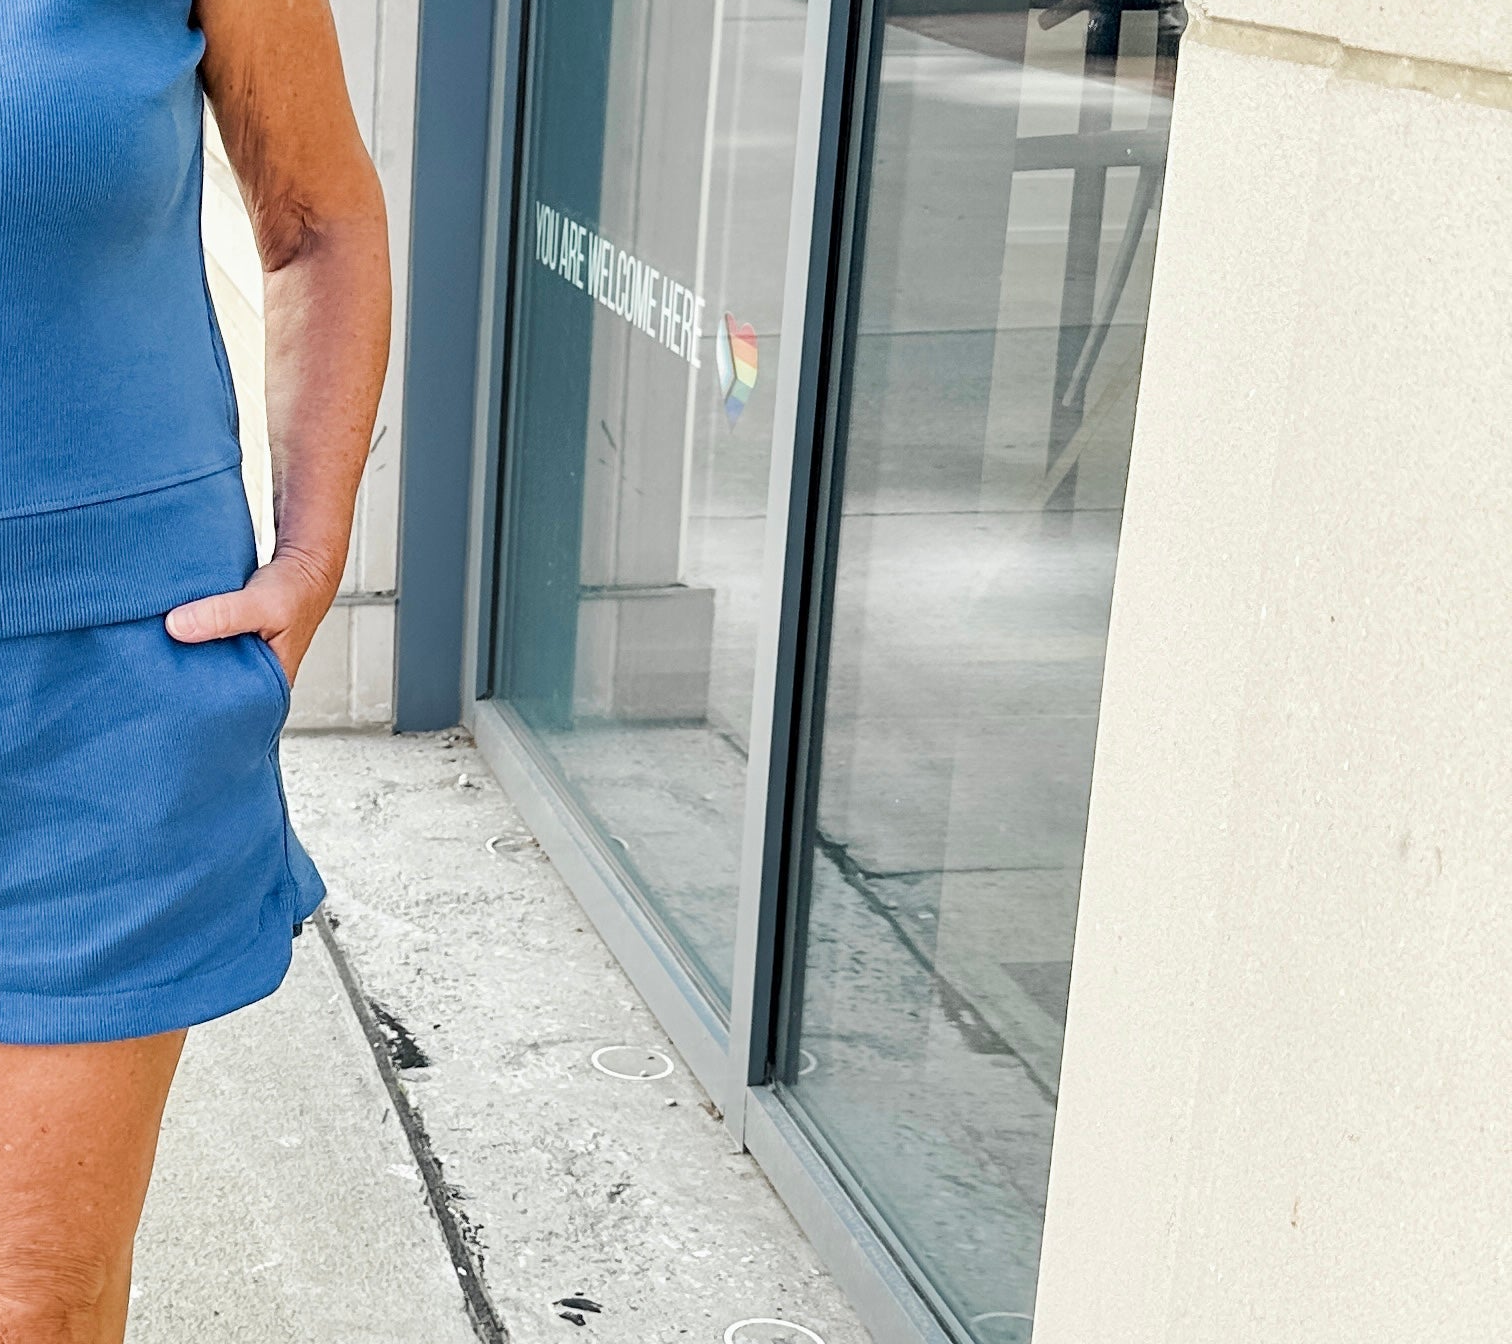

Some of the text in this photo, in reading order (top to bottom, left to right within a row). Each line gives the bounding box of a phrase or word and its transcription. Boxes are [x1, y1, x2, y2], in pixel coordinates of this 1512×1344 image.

[536, 201, 706, 369] YOU ARE WELCOME HERE
